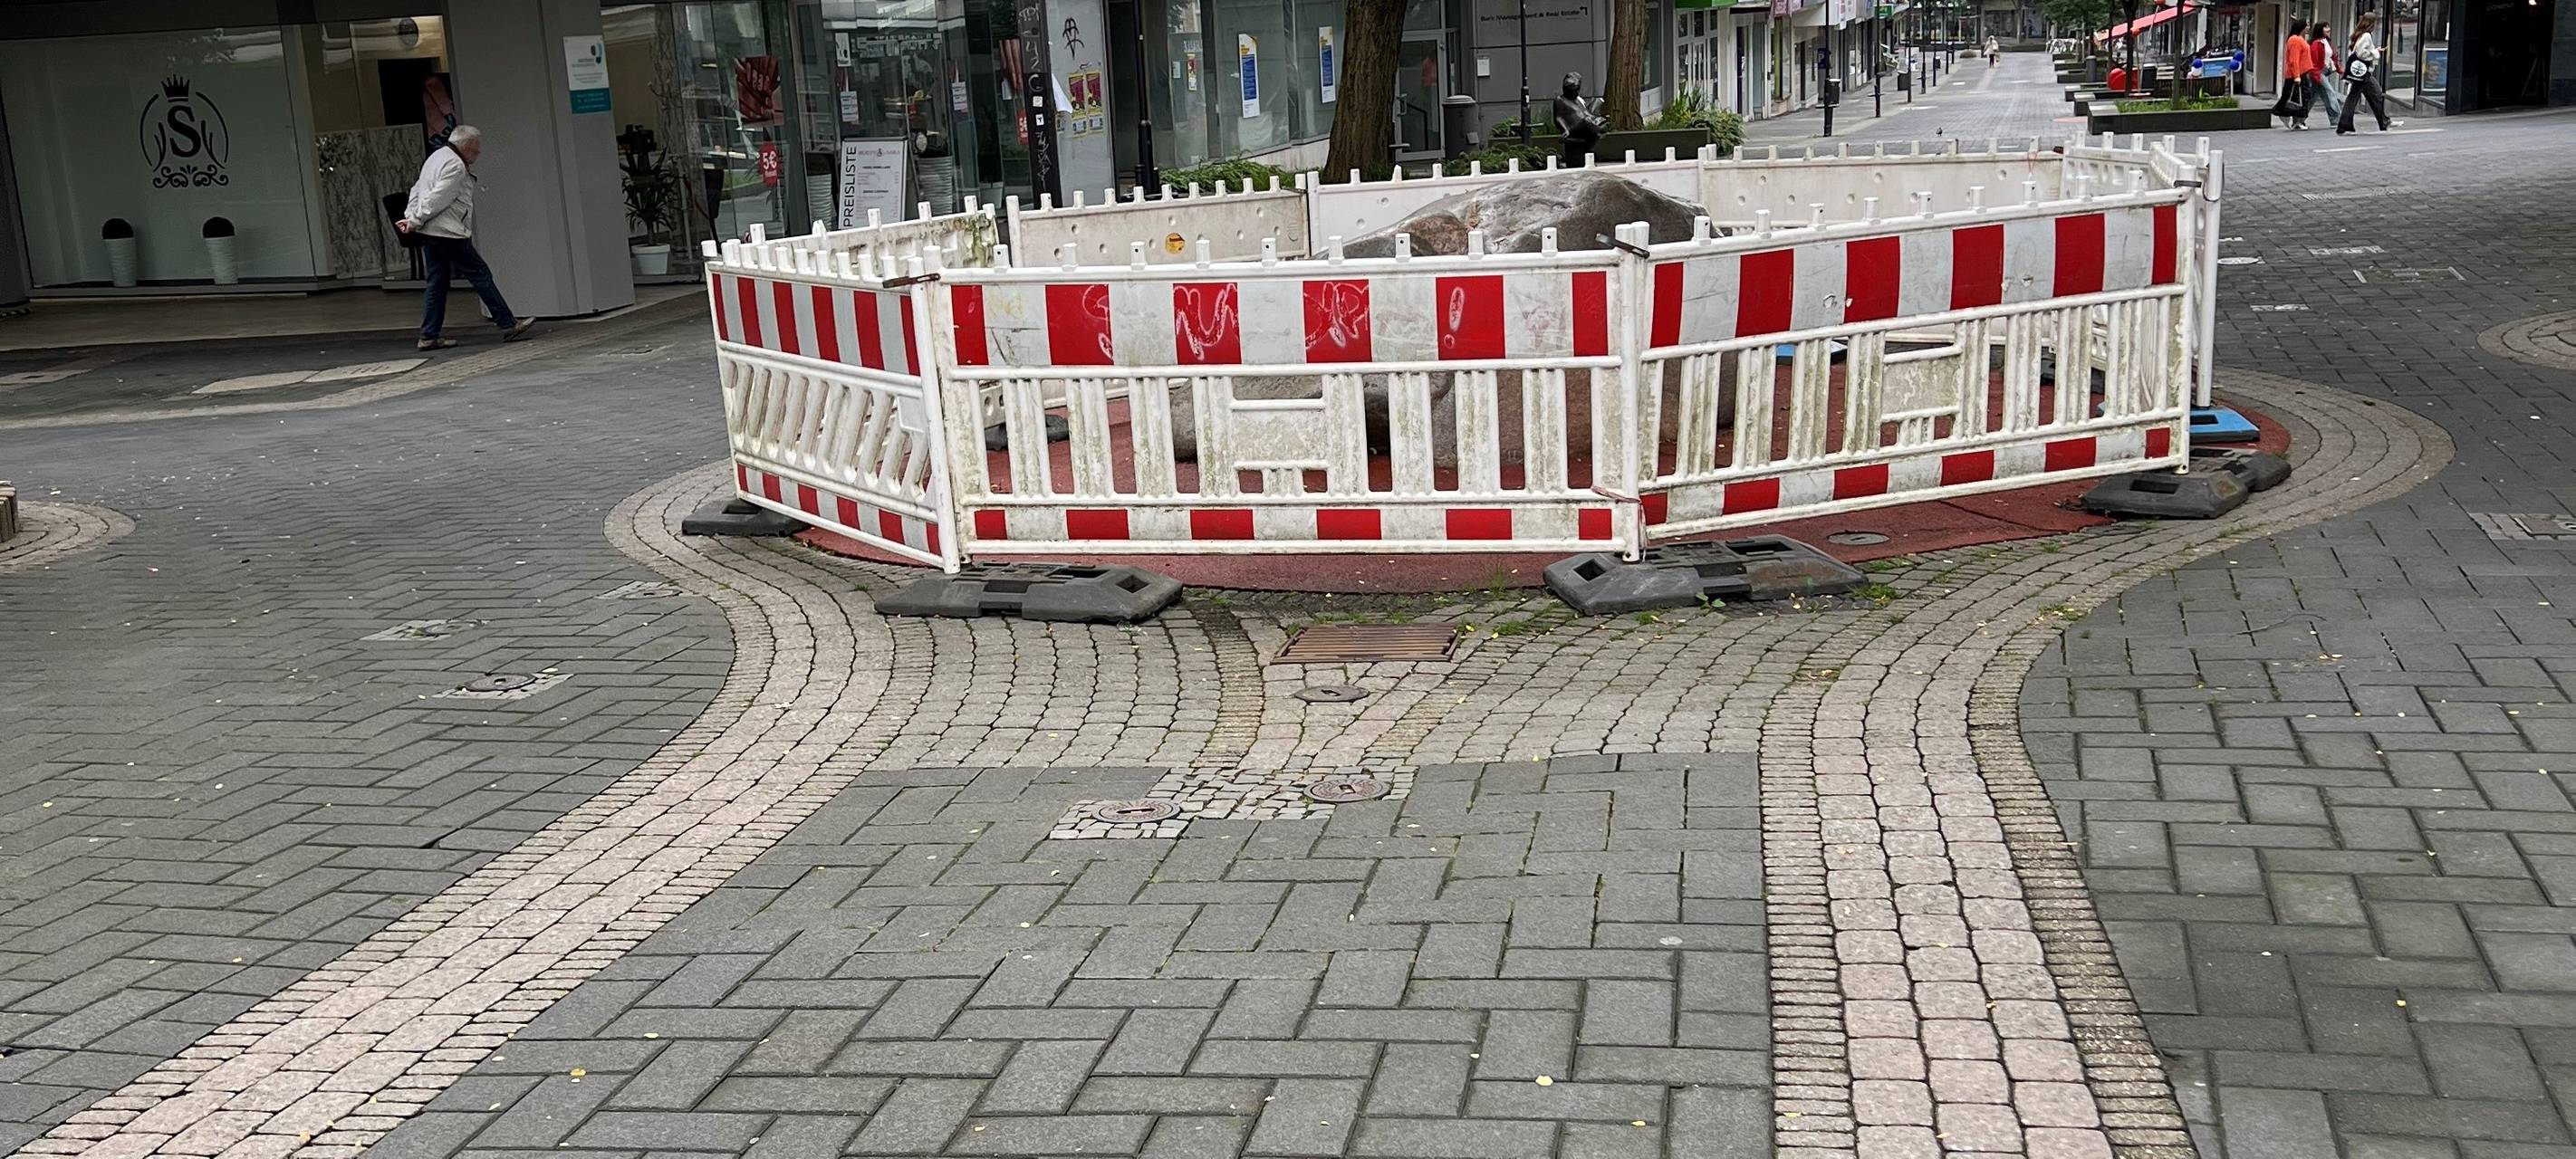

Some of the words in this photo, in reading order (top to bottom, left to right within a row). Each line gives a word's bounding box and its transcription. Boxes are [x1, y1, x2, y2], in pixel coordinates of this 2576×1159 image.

[1496, 13, 1537, 22] Manageent
[168, 105, 201, 158] S
[762, 150, 777, 170] 5€
[842, 146, 857, 226] PREISLISTE
